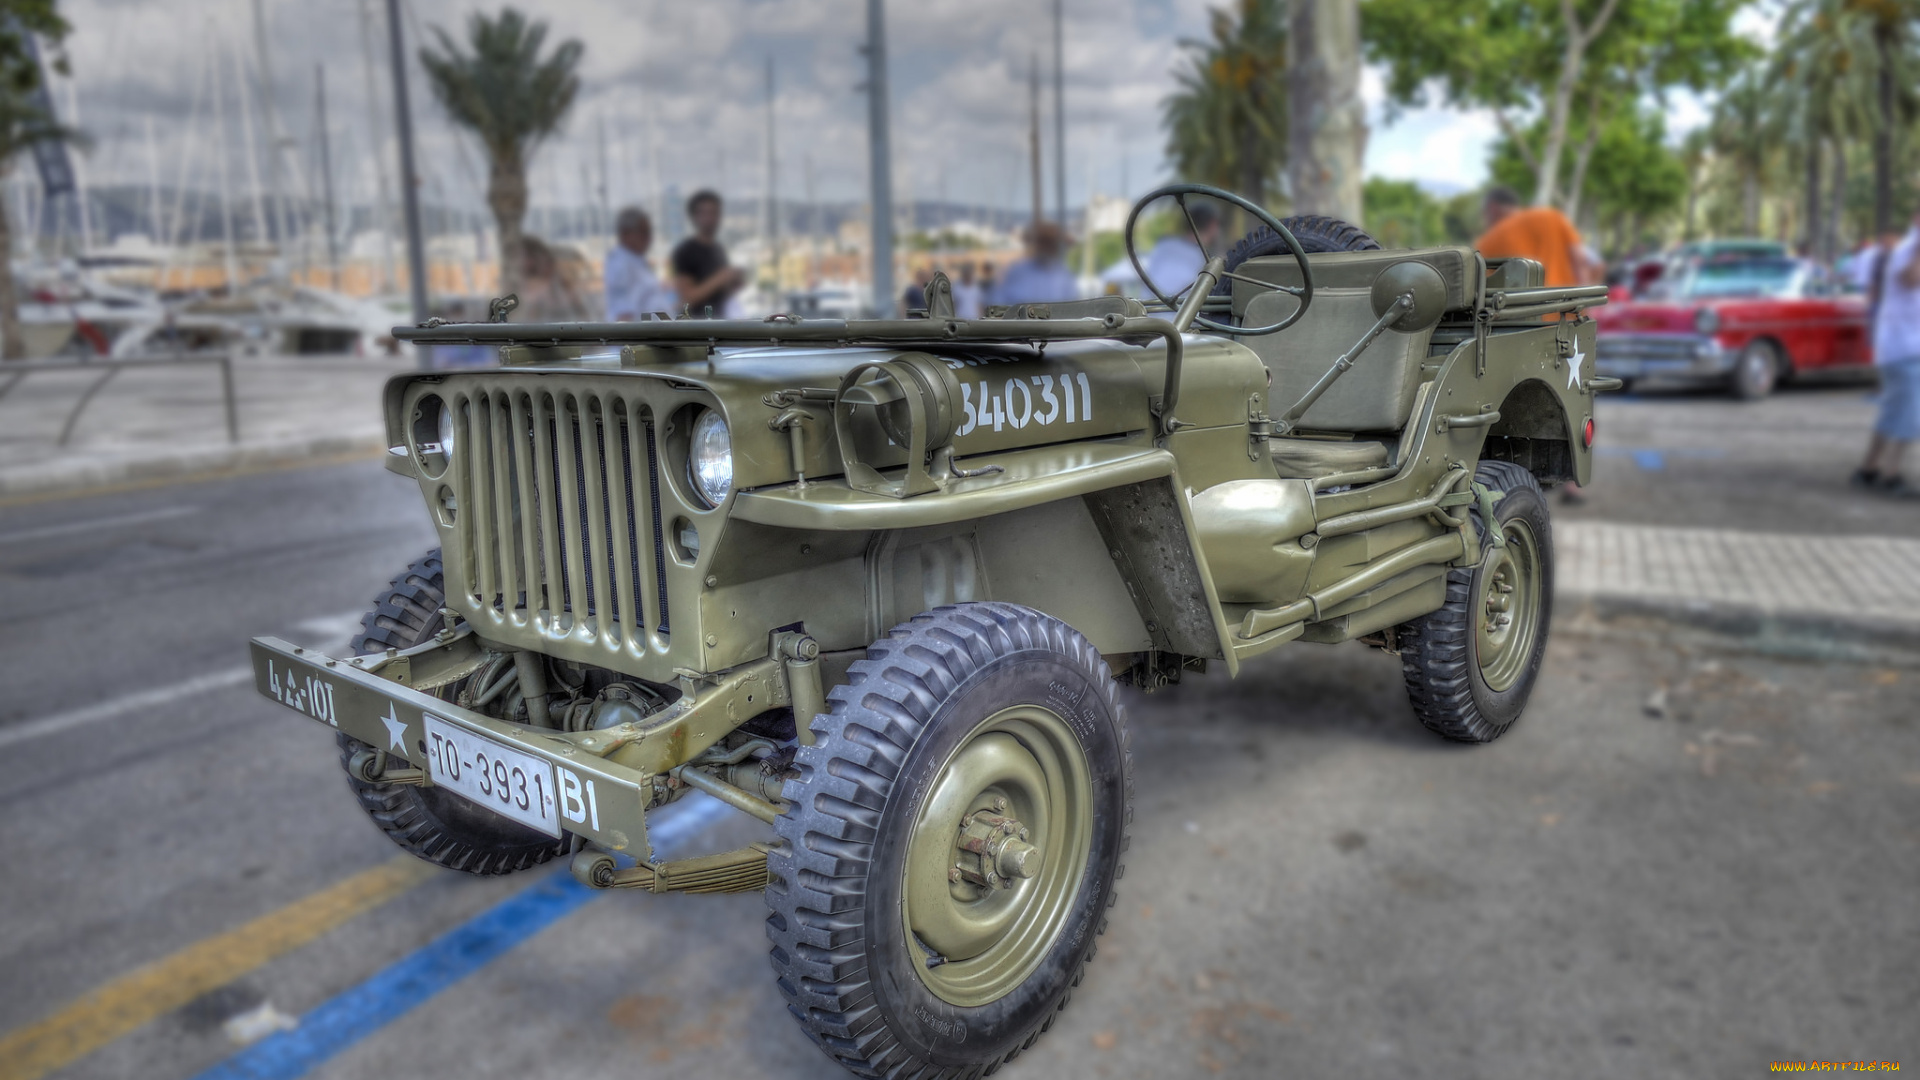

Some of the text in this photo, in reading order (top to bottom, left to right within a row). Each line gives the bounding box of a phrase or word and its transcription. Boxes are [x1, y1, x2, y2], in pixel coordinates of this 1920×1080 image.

[952, 372, 1093, 438] 340311
[431, 731, 547, 819] TO-3931
[556, 765, 600, 832] B1
